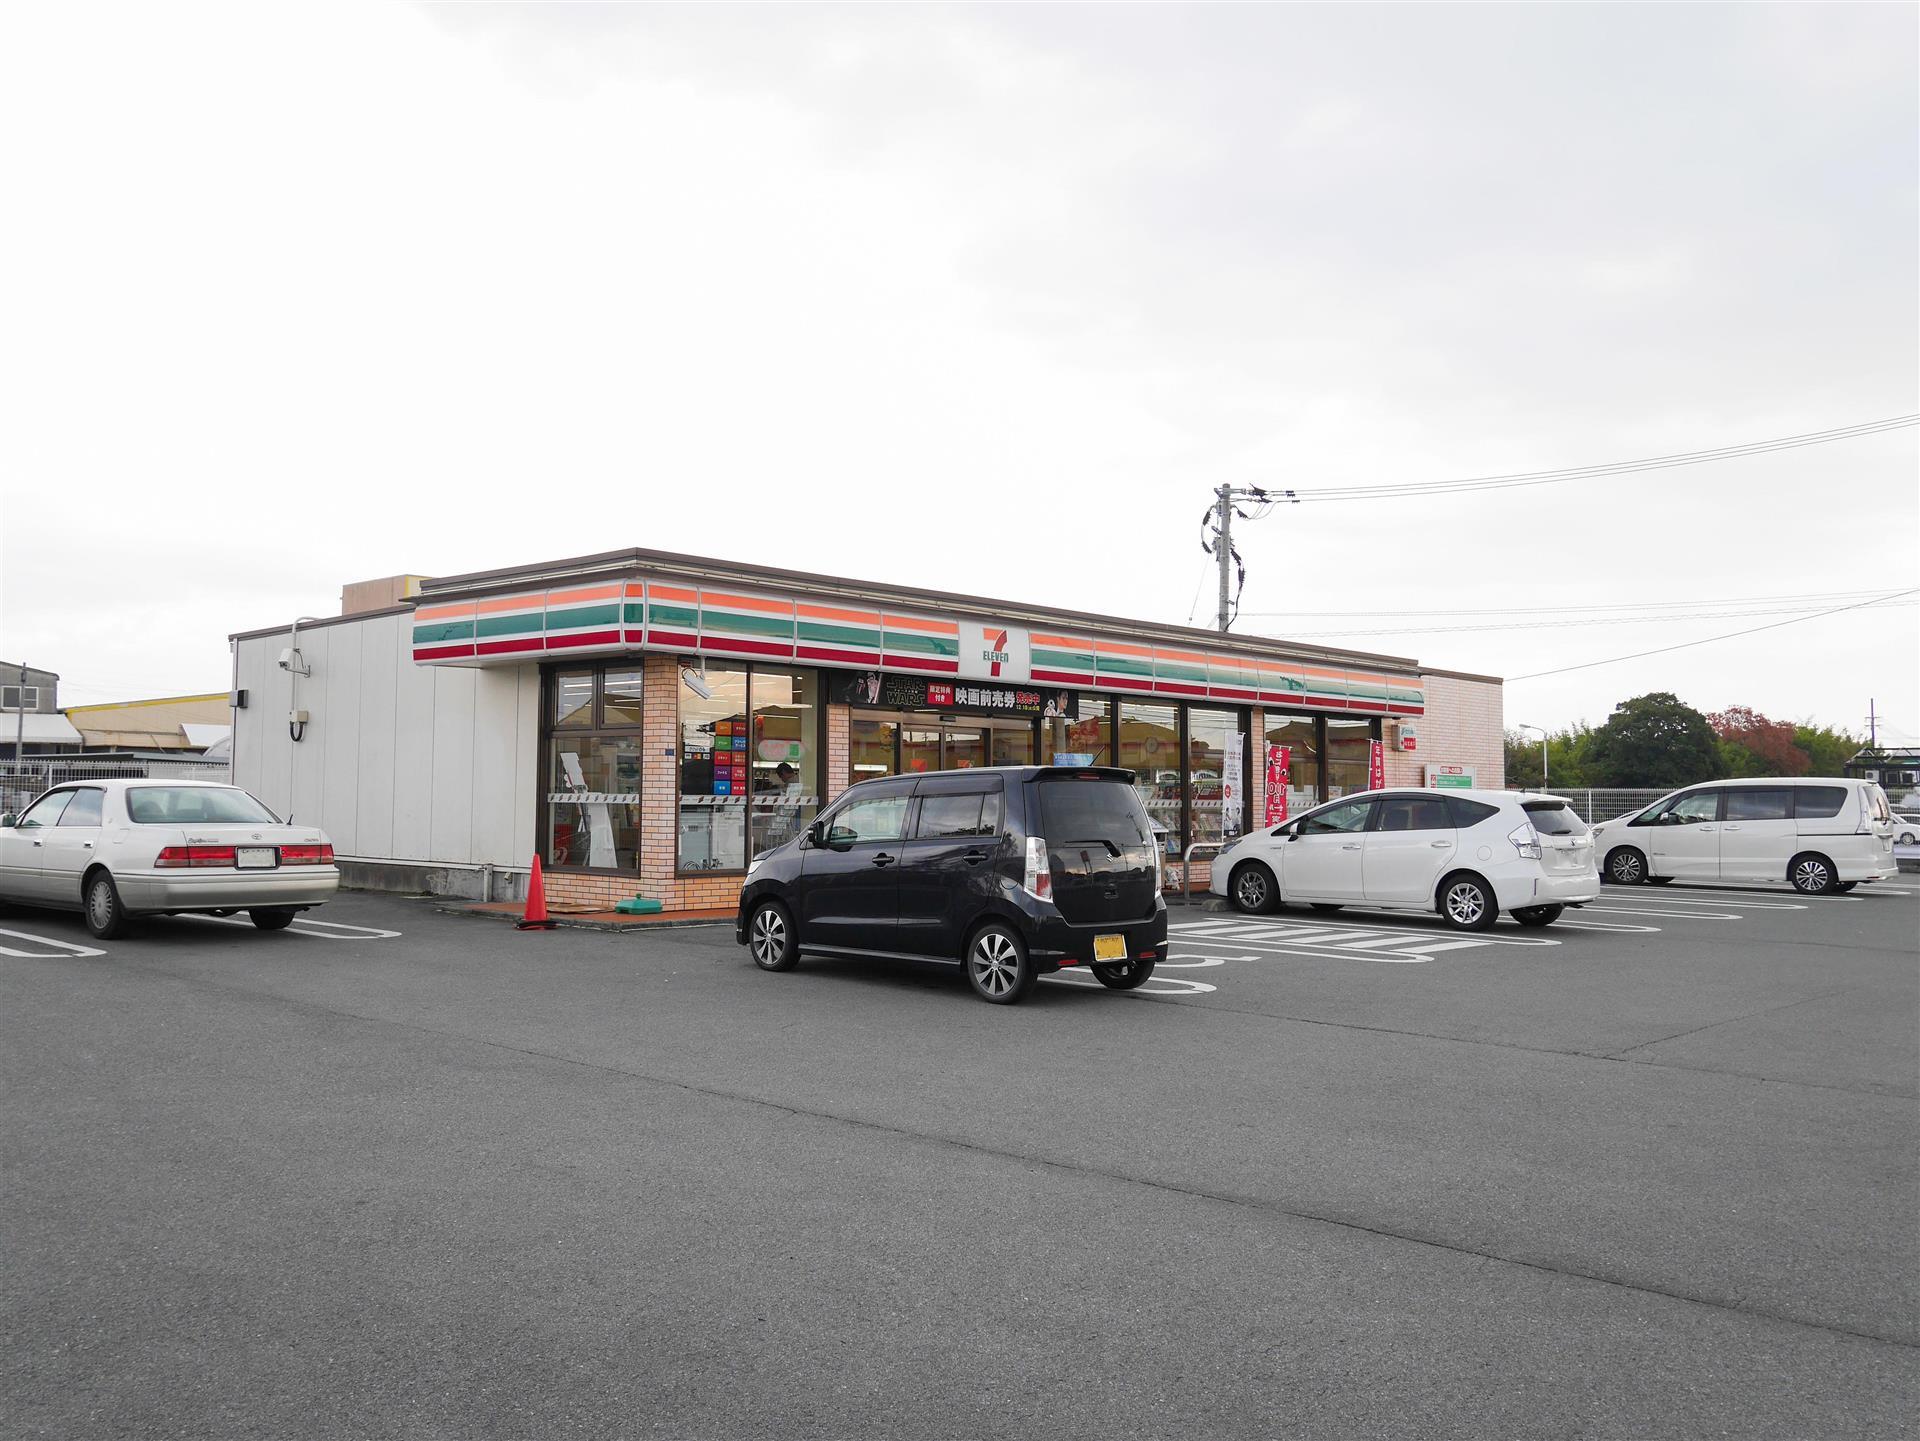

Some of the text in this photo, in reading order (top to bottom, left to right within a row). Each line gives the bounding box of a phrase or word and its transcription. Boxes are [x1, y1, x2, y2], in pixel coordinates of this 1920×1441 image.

[887, 676, 926, 690] STAR
[887, 691, 926, 707] WARS
[955, 687, 1040, 708] 映画前売券 発売中
